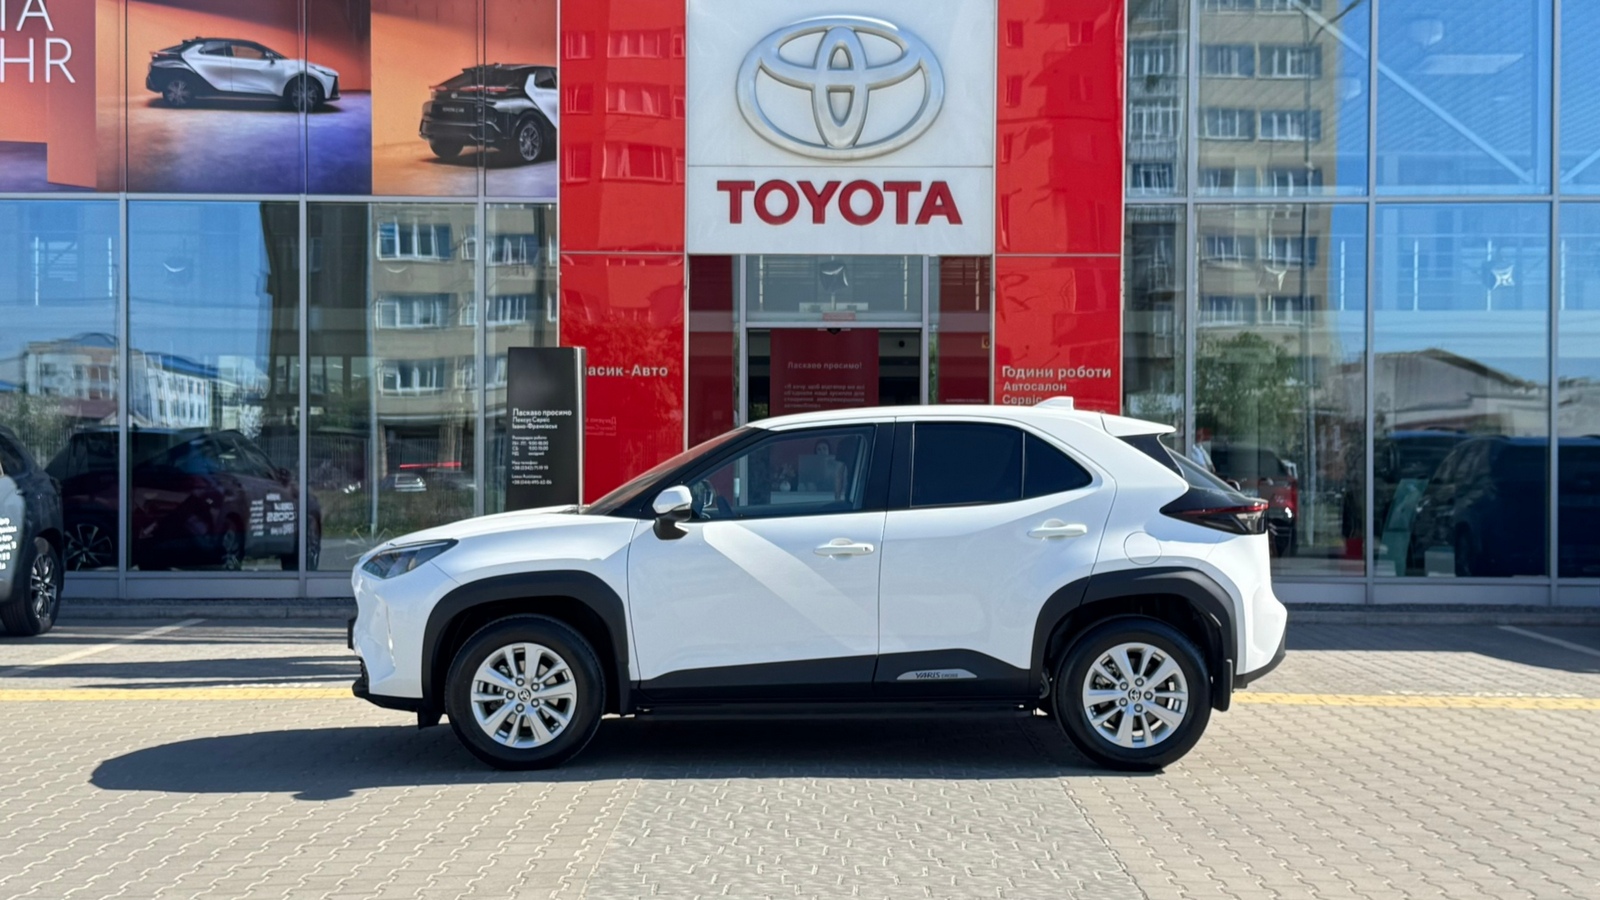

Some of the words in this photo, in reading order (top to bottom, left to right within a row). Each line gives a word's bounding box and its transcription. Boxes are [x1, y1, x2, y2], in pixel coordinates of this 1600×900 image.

[717, 179, 962, 225] TOYOTA
[787, 361, 822, 369] Ласкаво
[823, 361, 862, 370] просимо!
[1002, 365, 1054, 379] Години
[1058, 365, 1111, 380] роботи
[1003, 381, 1067, 391] Автосалон
[542, 409, 572, 417] просимо
